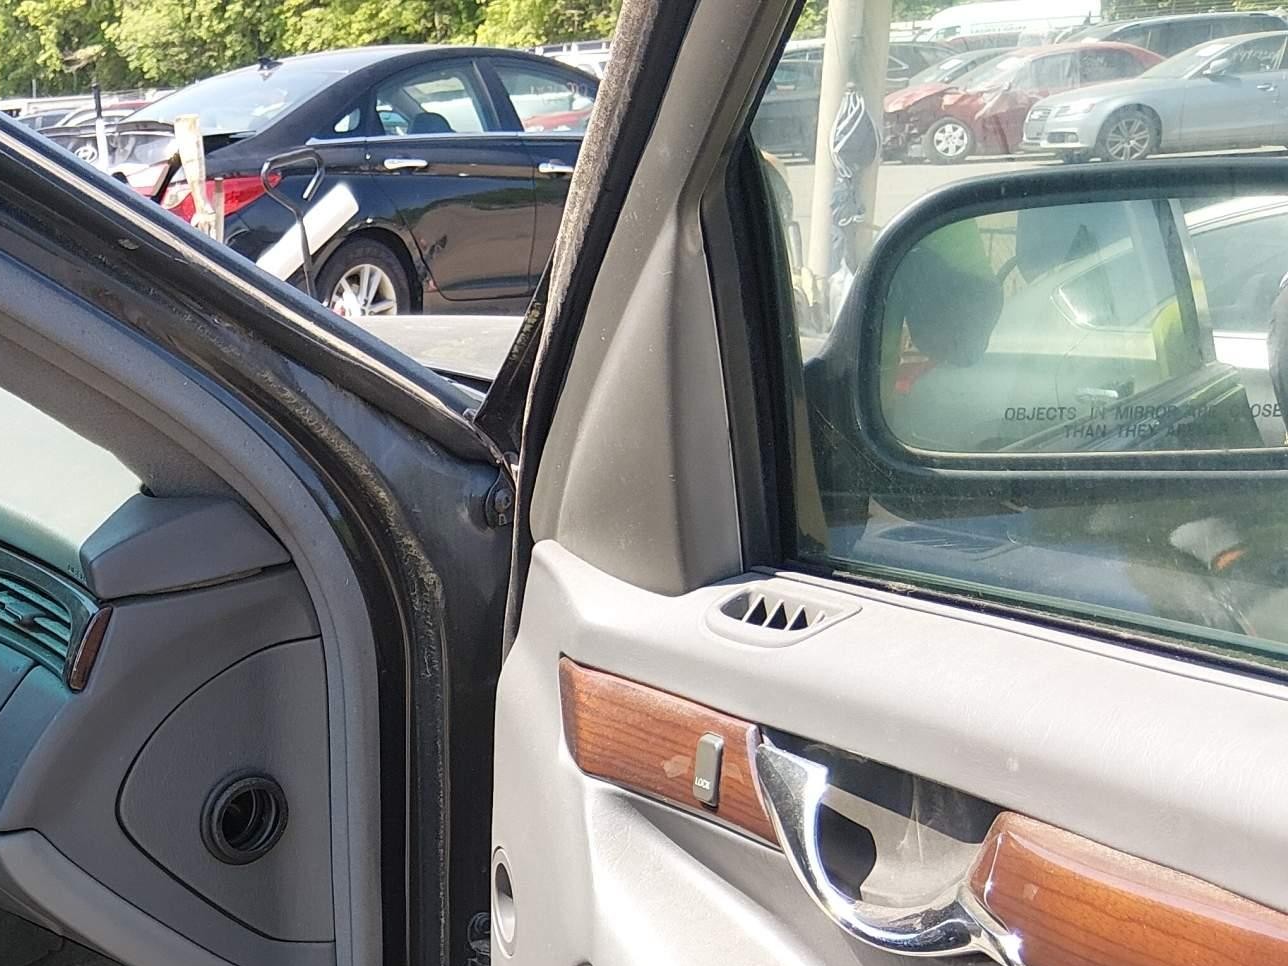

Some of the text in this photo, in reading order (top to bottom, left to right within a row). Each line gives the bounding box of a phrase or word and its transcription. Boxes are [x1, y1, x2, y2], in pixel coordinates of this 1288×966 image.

[1003, 406, 1078, 421] OBJECTS
[1090, 406, 1106, 420] IN
[1063, 424, 1107, 438] THAN
[1118, 423, 1158, 438] THEY
[694, 776, 711, 790] LOCK
